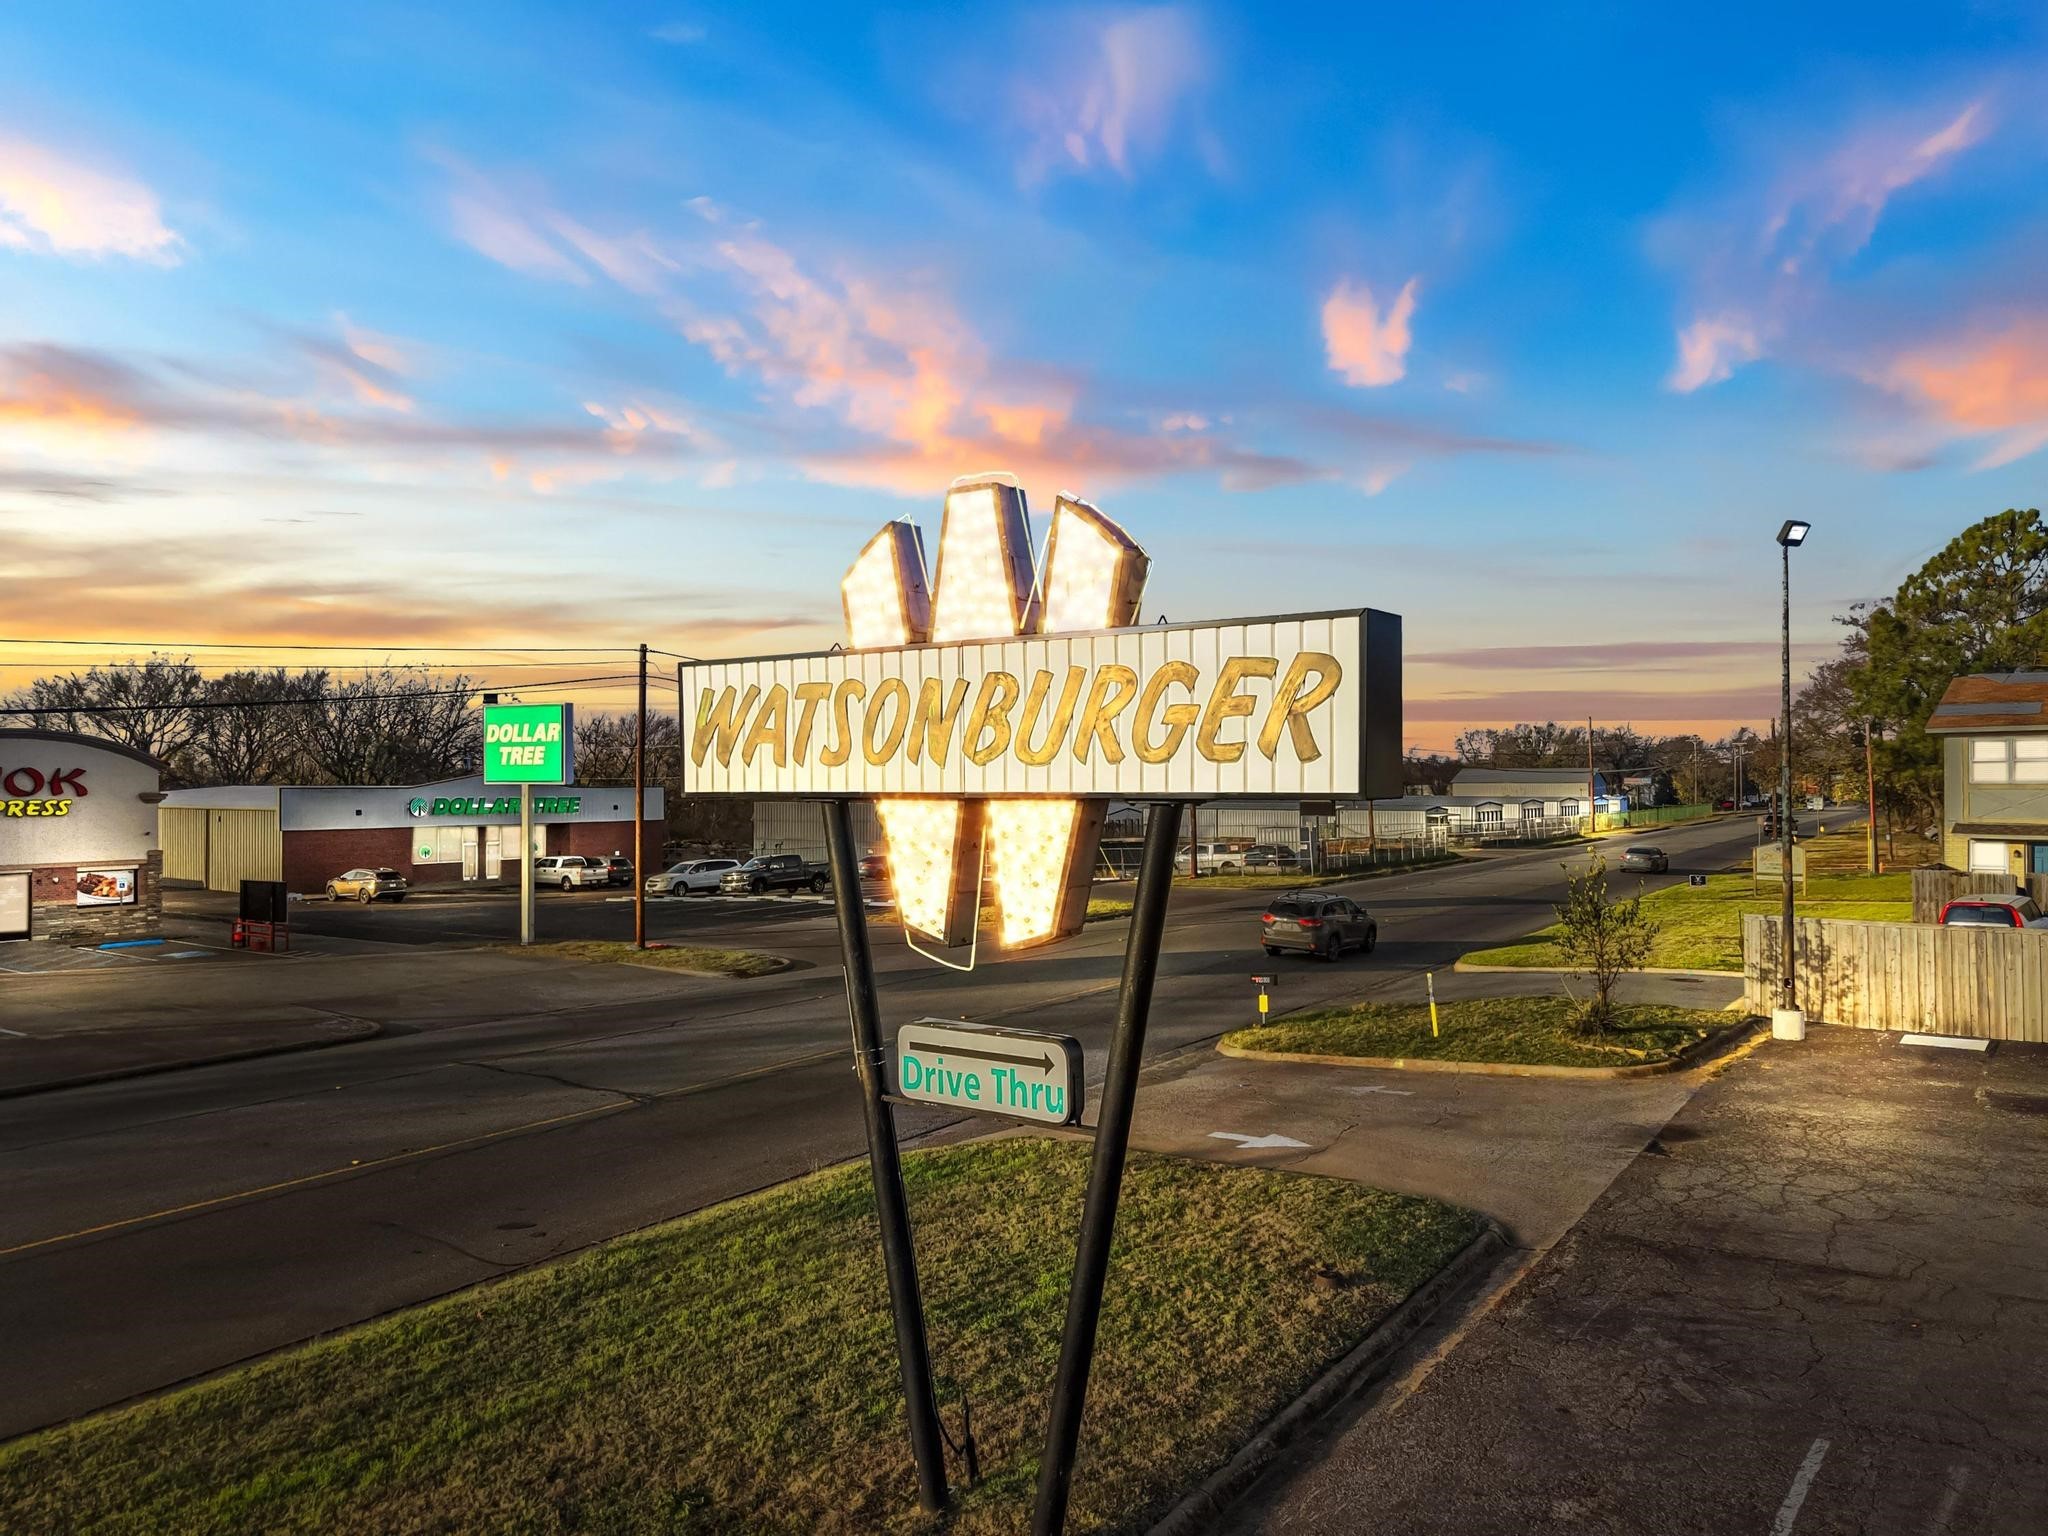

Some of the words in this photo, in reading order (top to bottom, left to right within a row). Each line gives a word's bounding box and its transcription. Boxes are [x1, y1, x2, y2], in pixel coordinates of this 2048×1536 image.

[691, 652, 1342, 768] WATSONBURGER
[486, 722, 561, 743] DOLLAR
[499, 746, 546, 765] TREE
[0, 766, 89, 797] OK
[431, 796, 521, 815] DOLLAR
[903, 1056, 980, 1101] Drive
[991, 1068, 1064, 1114] Thru
